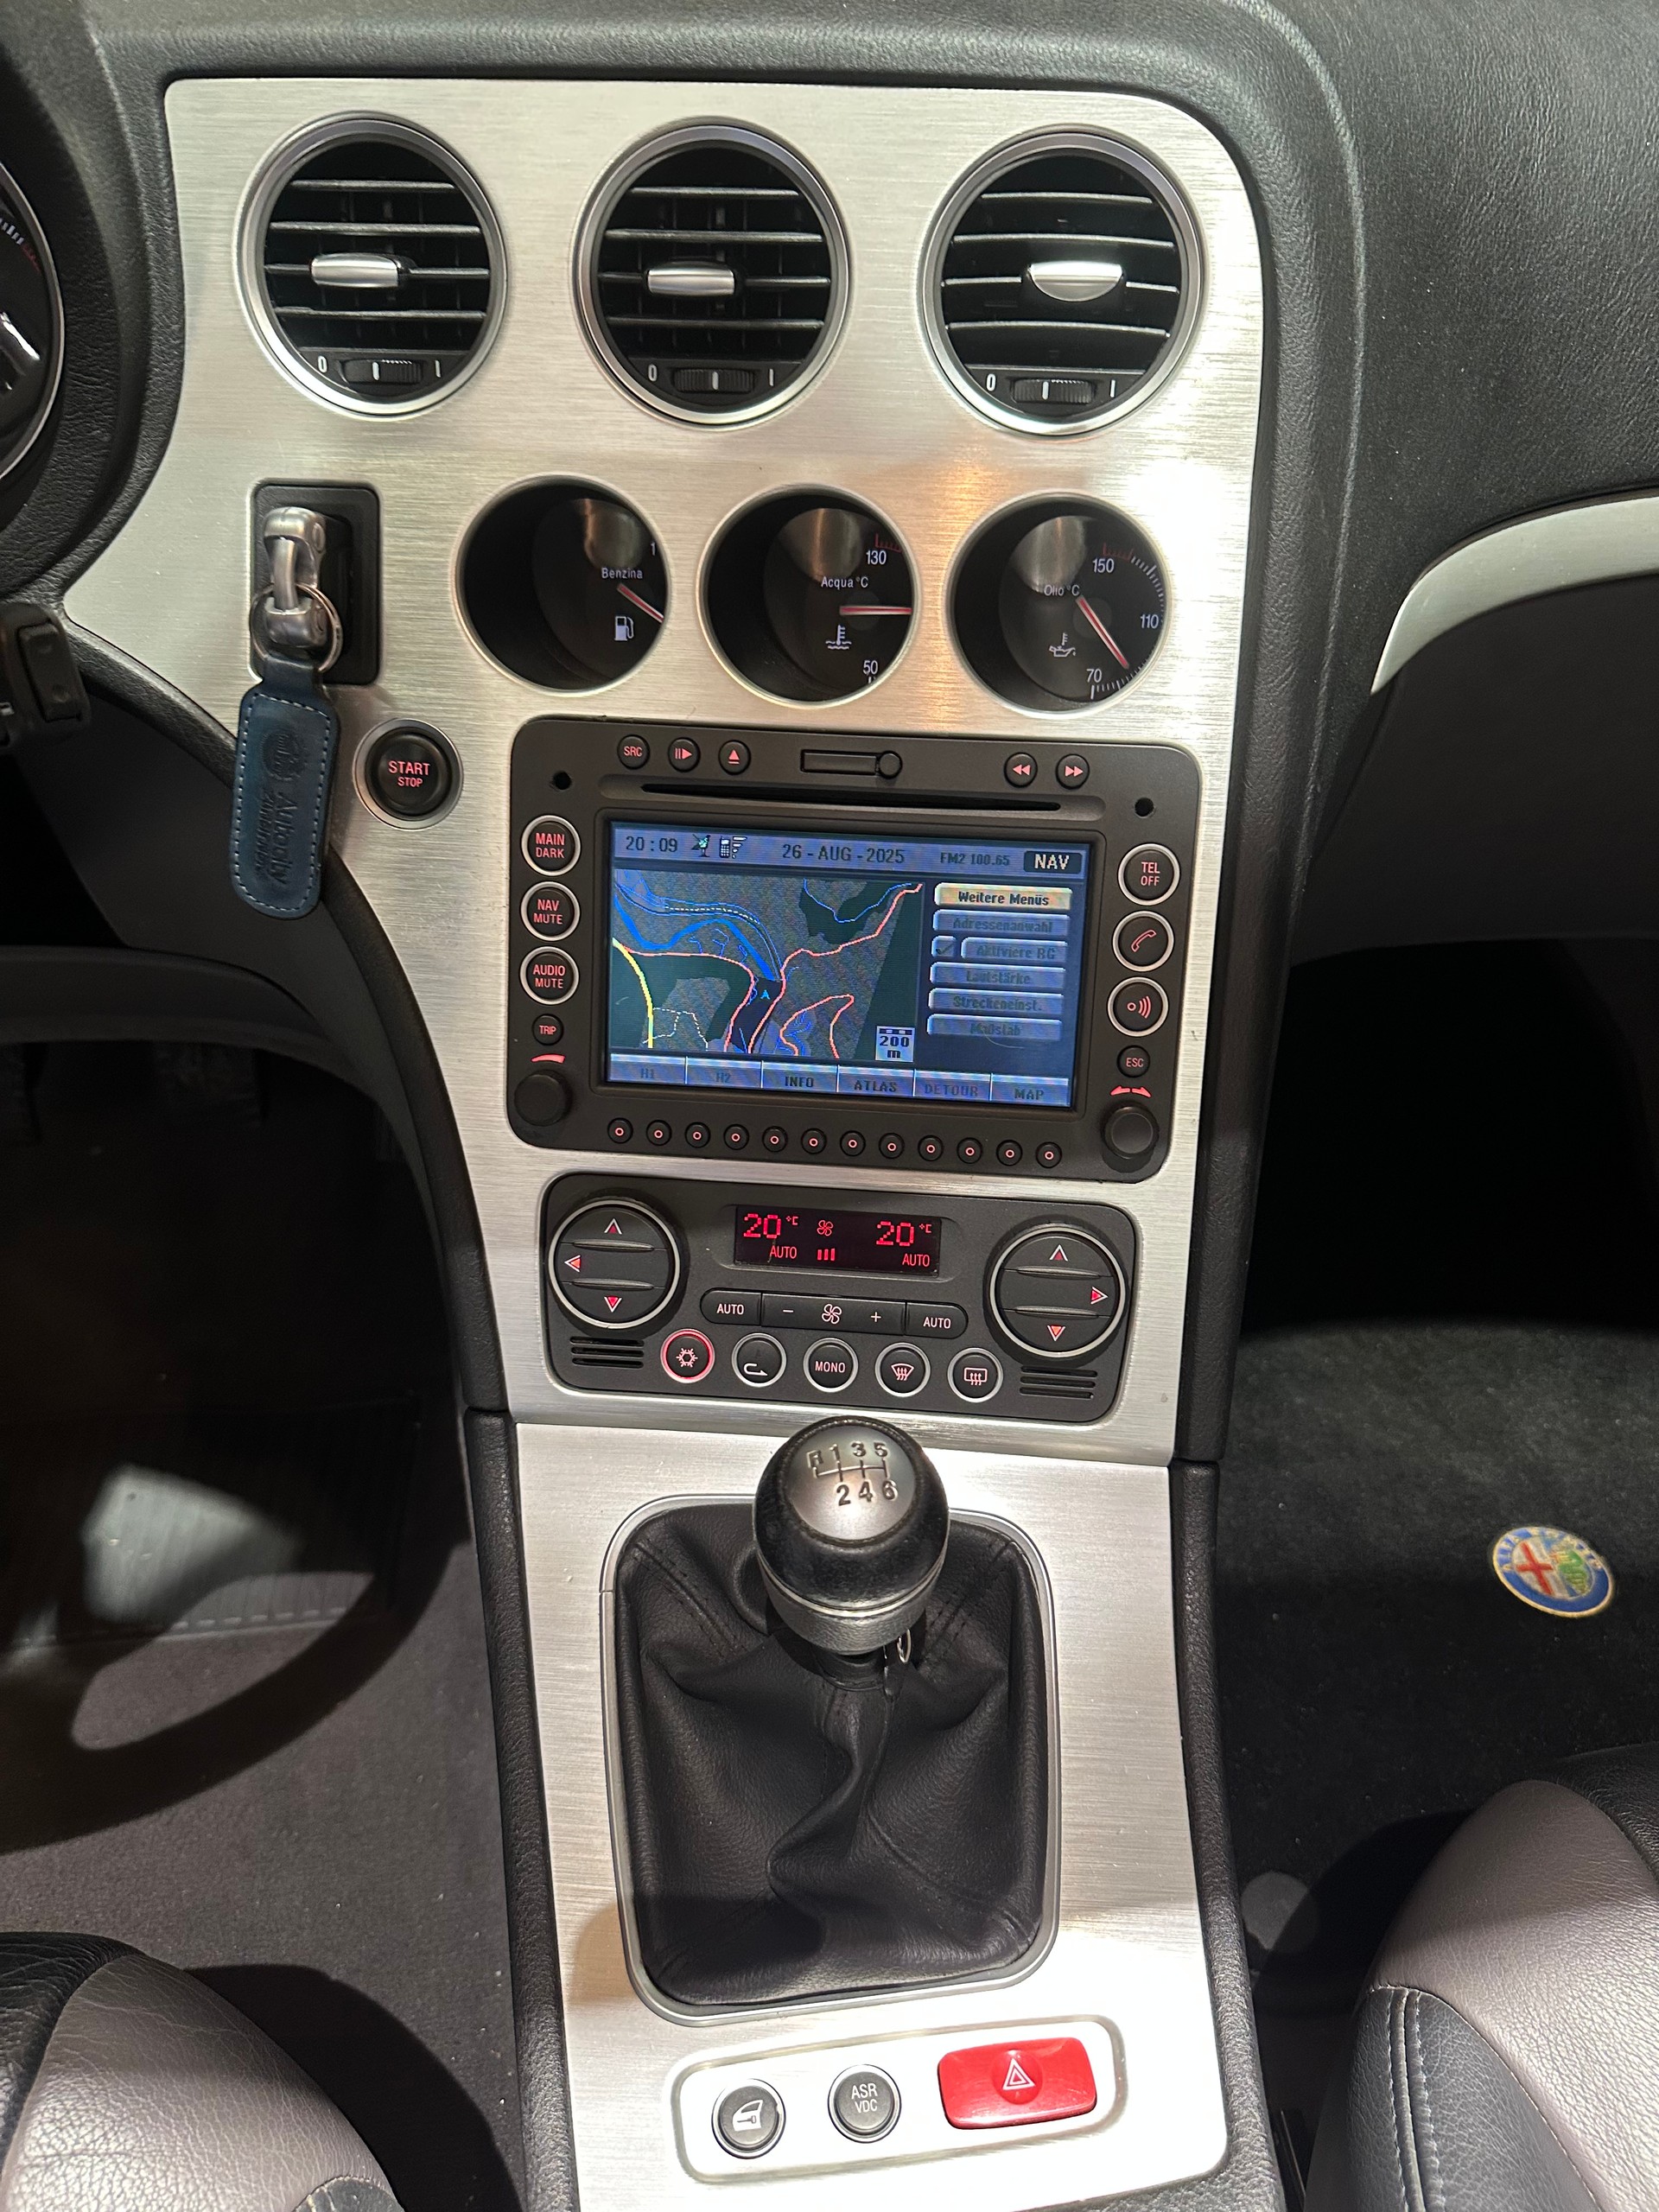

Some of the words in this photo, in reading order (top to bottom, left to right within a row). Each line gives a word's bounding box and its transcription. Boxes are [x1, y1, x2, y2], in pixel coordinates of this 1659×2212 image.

[866, 550, 887, 565] 130
[1092, 558, 1115, 573] 150
[601, 567, 644, 580] Benzina
[821, 576, 854, 590] Acqua
[856, 576, 869, 588] °C
[1140, 613, 1159, 629] 110
[862, 660, 879, 674] 50
[1086, 669, 1103, 683] 70
[623, 746, 643, 757] SRC
[388, 760, 430, 776] START
[397, 777, 423, 787] STOP
[535, 833, 565, 846] MAIN
[535, 848, 565, 859] DARK
[940, 852, 965, 864] FM2
[971, 853, 1010, 866] 100.65
[1034, 854, 1070, 871] NAV
[1141, 861, 1160, 874] TEL
[1141, 876, 1160, 886] OFF
[958, 891, 1005, 904] Weitere
[1009, 893, 1050, 906] Menüs
[537, 899, 560, 912] NAV
[533, 912, 563, 925] MUTE
[953, 917, 1052, 933] Adressenanwahl
[532, 964, 566, 976] AUDIO
[535, 978, 563, 988] MUTE
[538, 1025, 557, 1035] TRIP
[879, 1035, 910, 1047] 200
[887, 1050, 900, 1059] m
[1126, 1058, 1144, 1068] ESC
[785, 1076, 814, 1088] INFO
[854, 1079, 897, 1093] ATLAS
[925, 1084, 978, 1096] DETOUR
[1014, 1088, 1044, 1100] MAP
[770, 1245, 798, 1259] AUTO
[902, 1254, 931, 1268] AUTO
[716, 1303, 745, 1315] AUTO
[923, 1316, 951, 1329] AUTO
[815, 1360, 846, 1373] MONO
[830, 1444, 840, 1461] 1
[851, 1441, 866, 1457] 3
[874, 1441, 888, 1458] 5
[836, 1484, 851, 1506] 2
[859, 1480, 874, 1502] 4
[882, 1479, 899, 1501] 6
[851, 2083, 878, 2100] ASR
[855, 2099, 878, 2113] VDC
